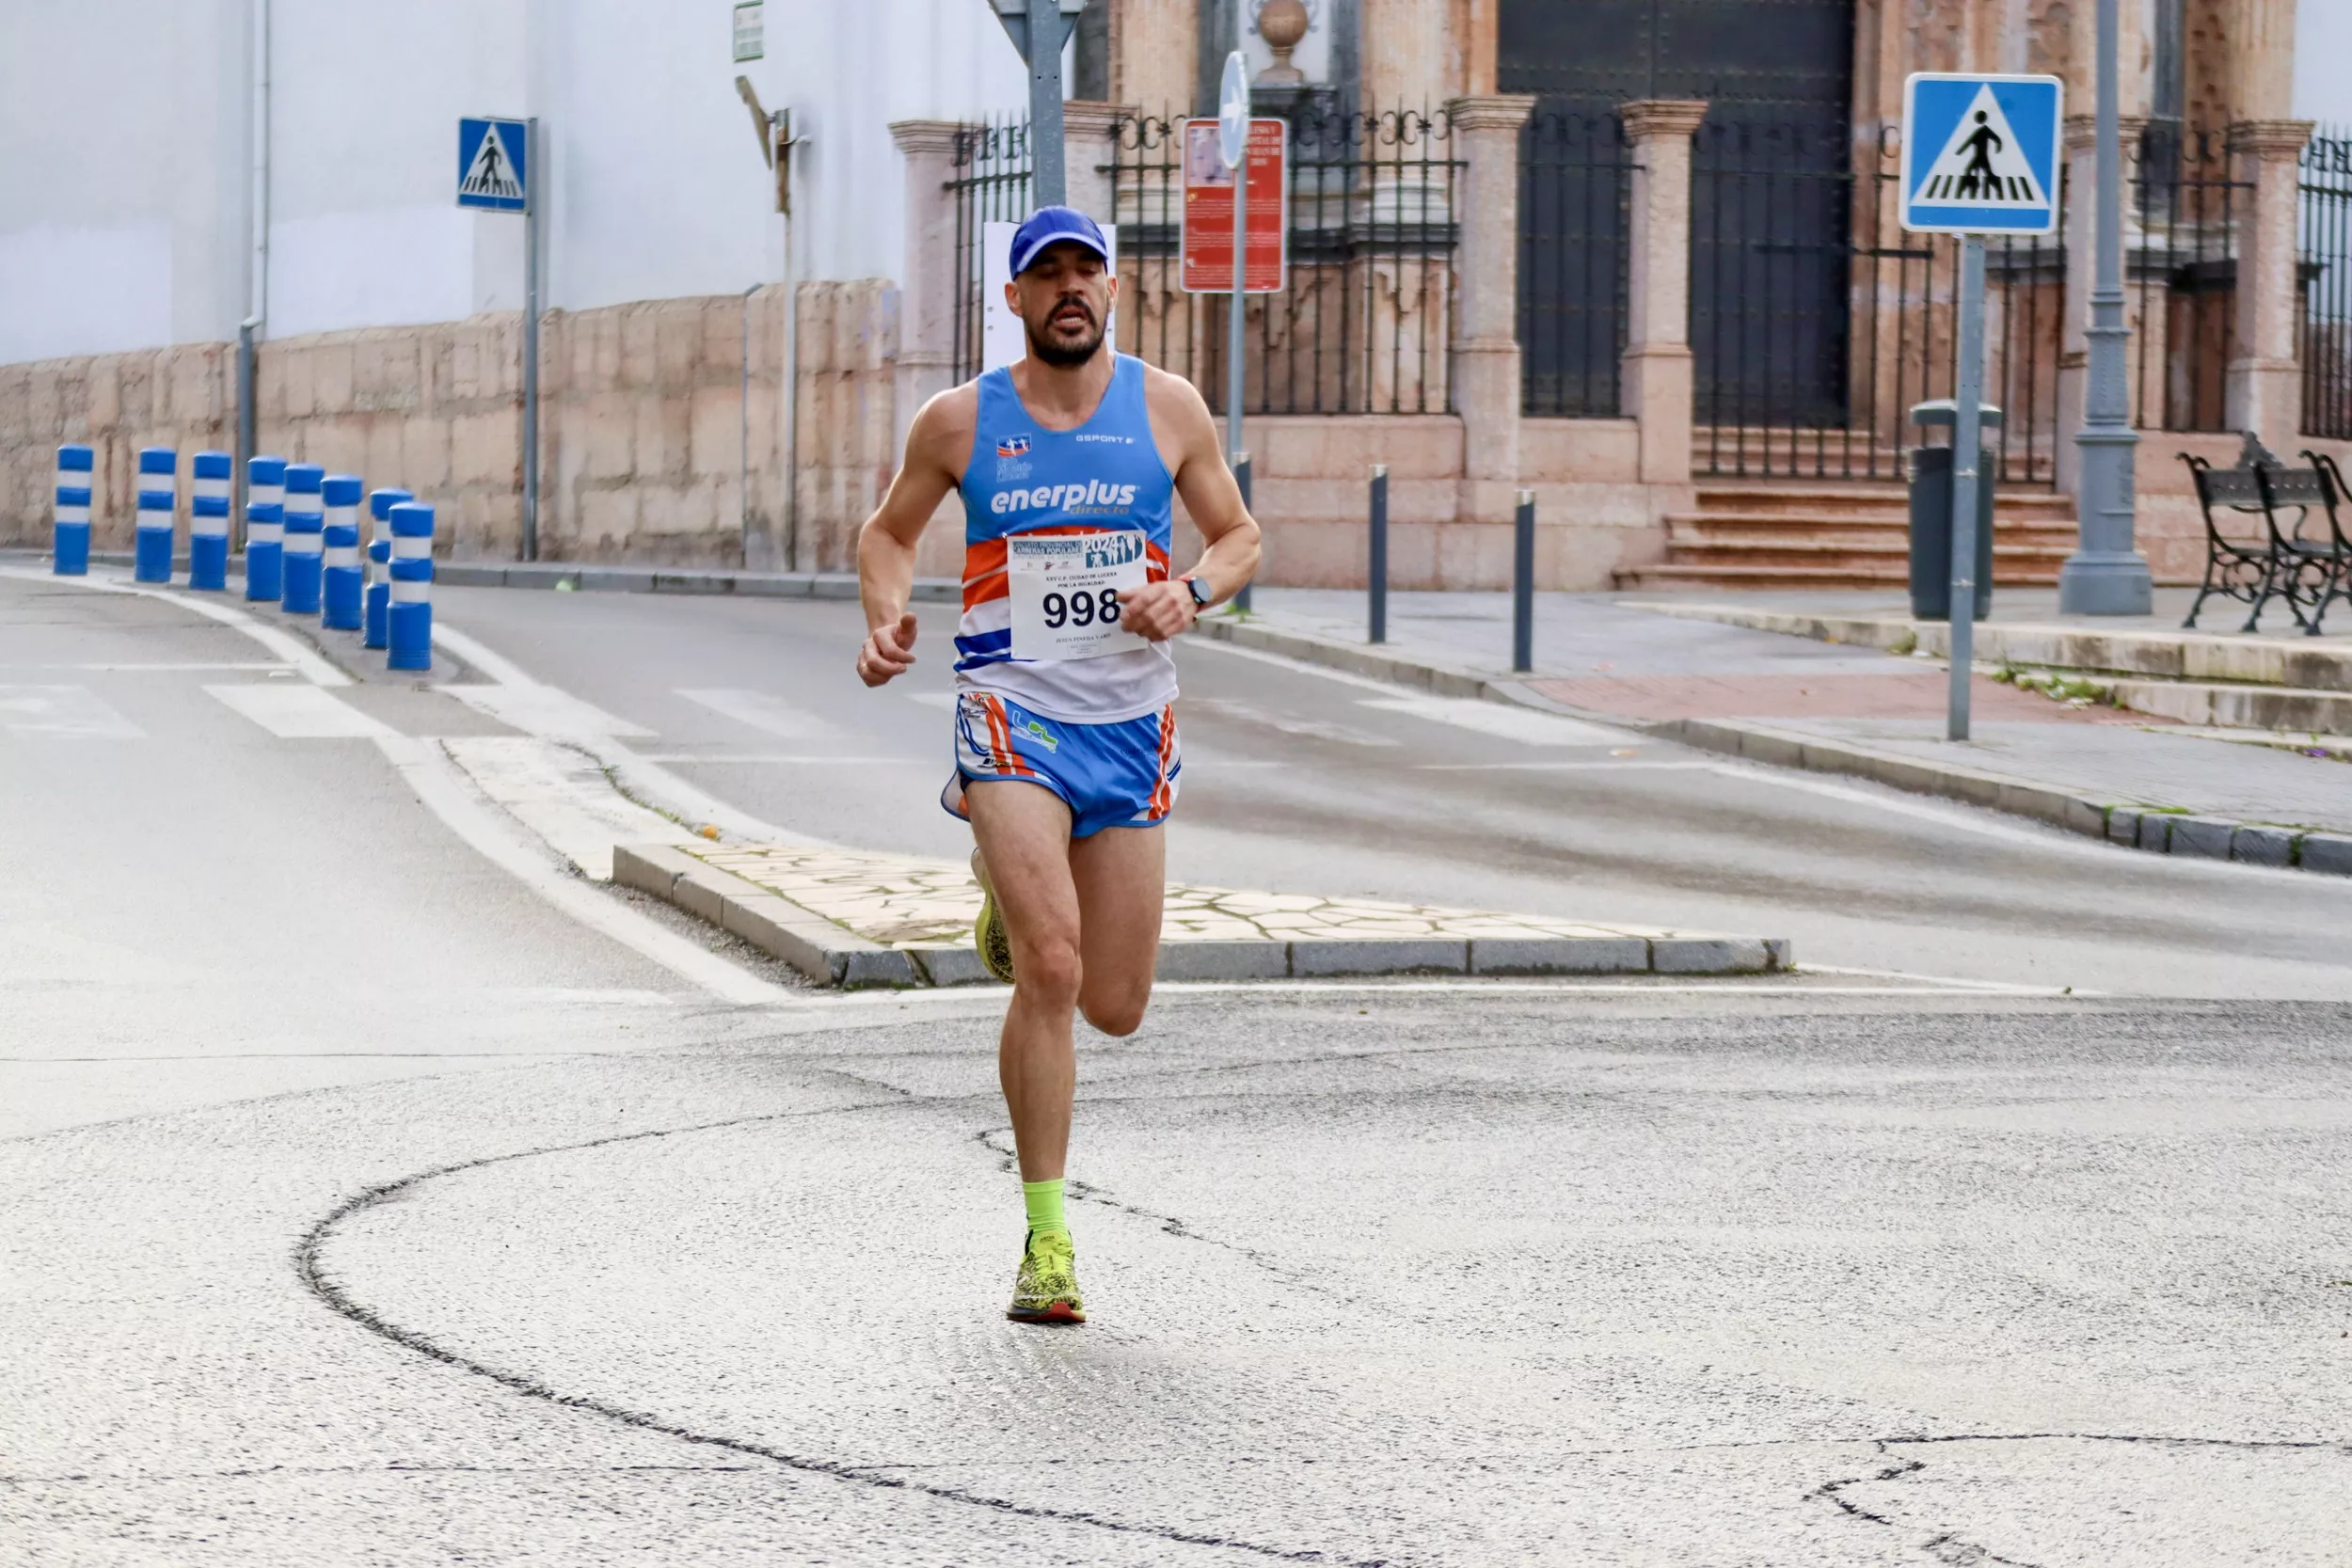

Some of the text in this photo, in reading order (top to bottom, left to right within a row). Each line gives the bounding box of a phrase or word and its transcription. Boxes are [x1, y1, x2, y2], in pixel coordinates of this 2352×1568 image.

[991, 479, 1136, 515] enerplus
[1083, 537, 1119, 554] 2024
[1042, 588, 1121, 628] 998
